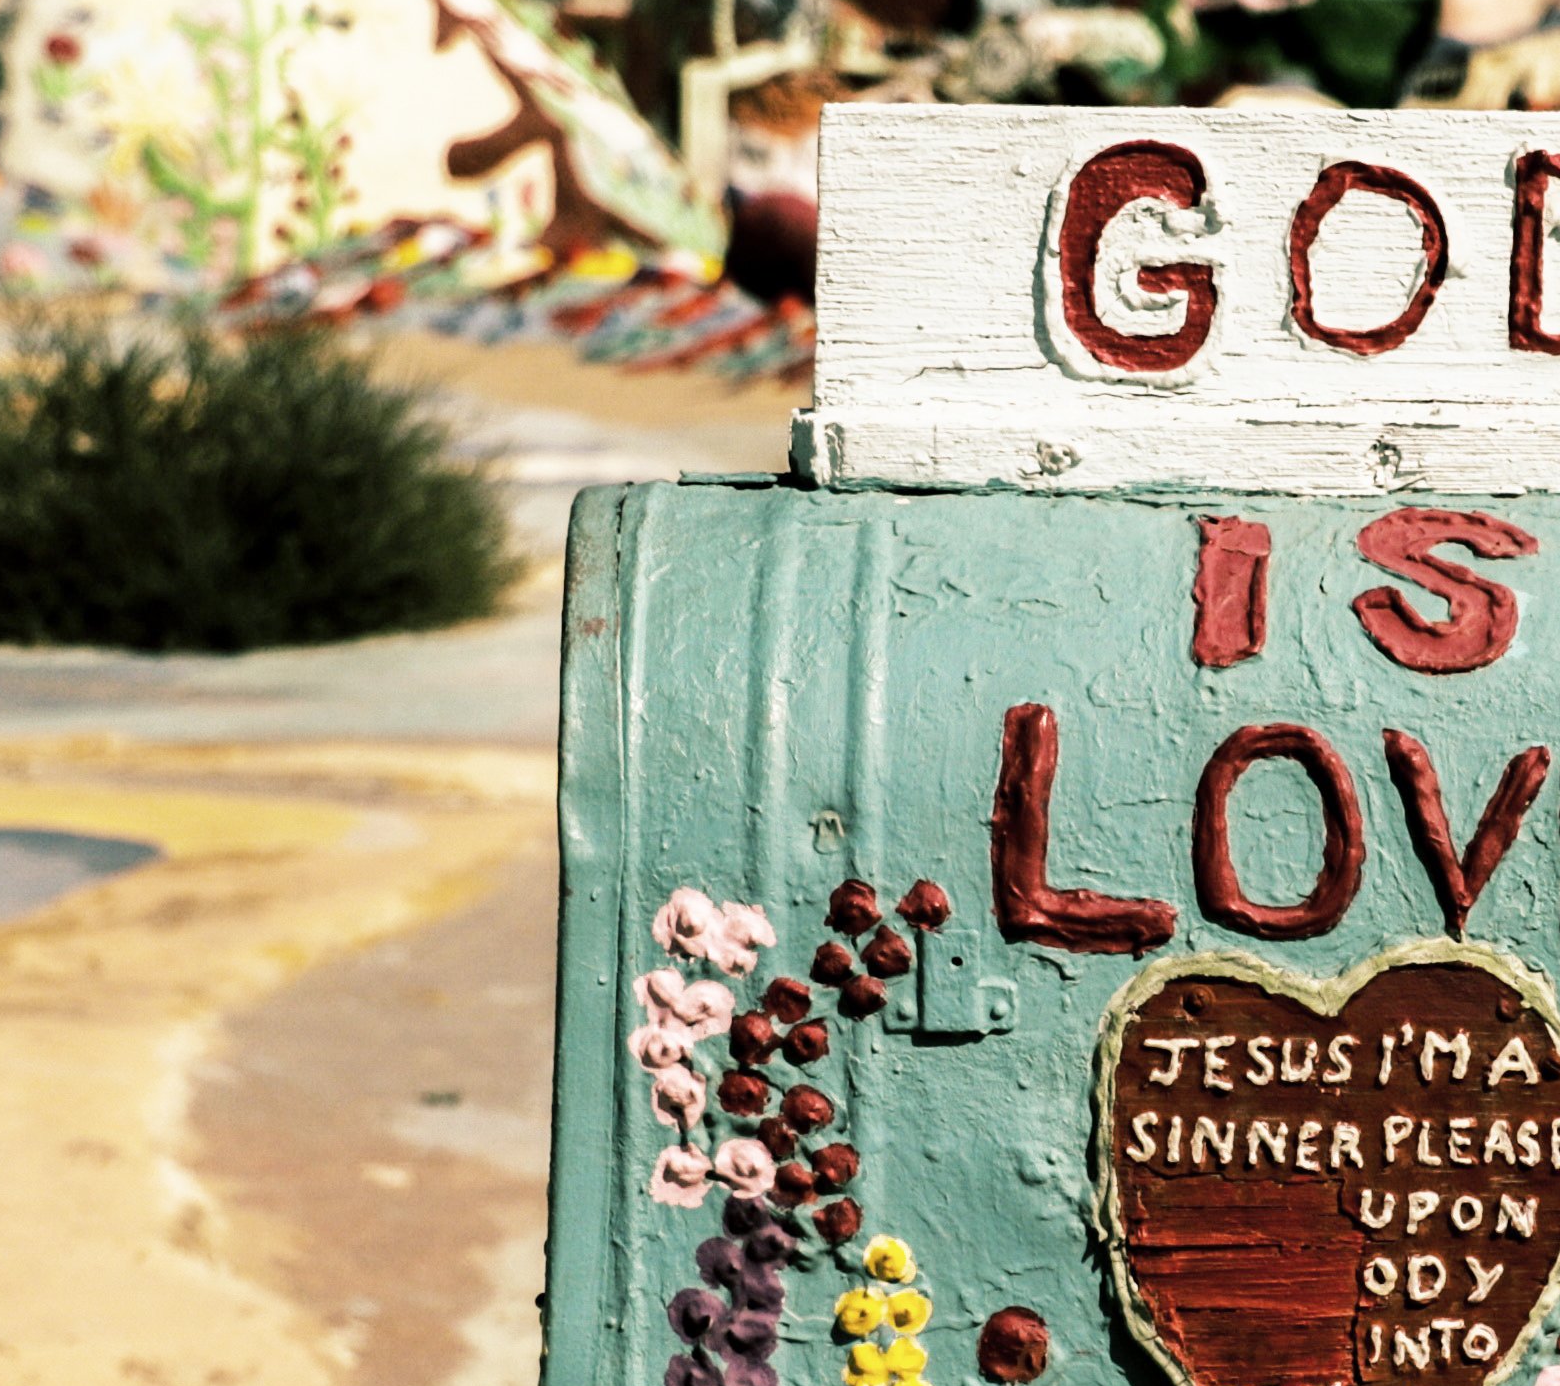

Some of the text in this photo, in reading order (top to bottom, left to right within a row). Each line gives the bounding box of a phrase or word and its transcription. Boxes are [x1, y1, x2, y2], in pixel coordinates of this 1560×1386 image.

[1190, 506, 1539, 674] IS
[1142, 1022, 1541, 1090] JESUS I'M A
[1126, 1111, 1364, 1172] SINNER
[1359, 1188, 1538, 1238] UPON
[1368, 1318, 1499, 1370] INTO
